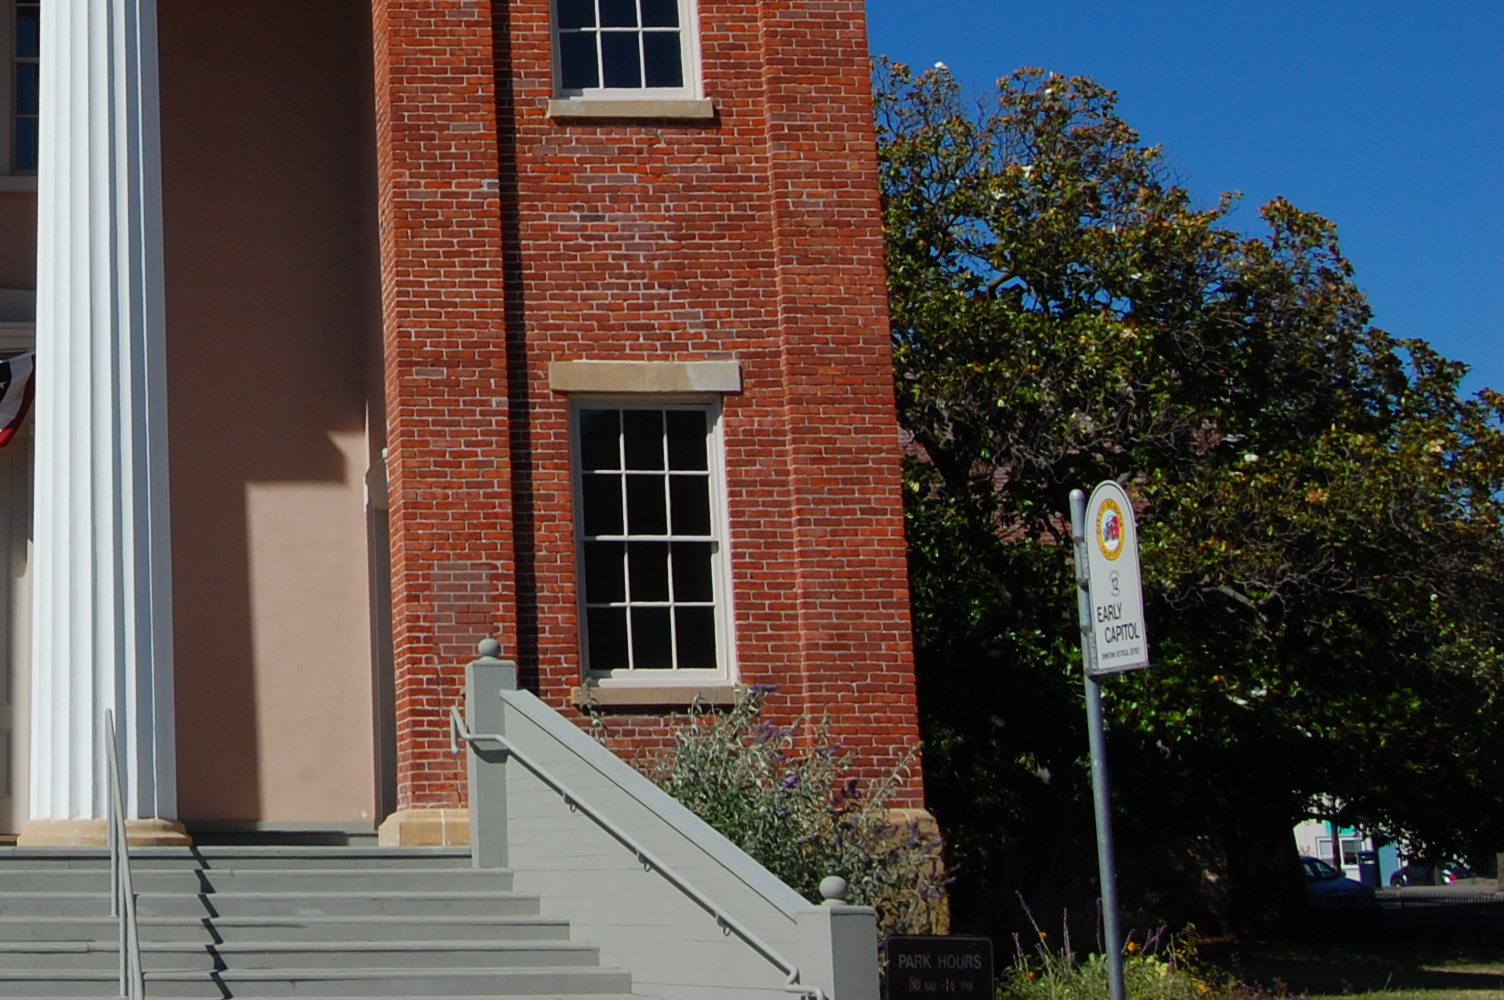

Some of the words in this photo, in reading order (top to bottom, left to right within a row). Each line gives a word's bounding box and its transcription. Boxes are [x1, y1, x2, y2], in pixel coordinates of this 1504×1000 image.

[1097, 602, 1121, 622] EARLY
[1105, 622, 1139, 643] CAPITOL
[898, 954, 931, 969] PARK
[937, 954, 982, 970] HOURS
[924, 981, 936, 992] AM
[961, 981, 973, 992] PM
